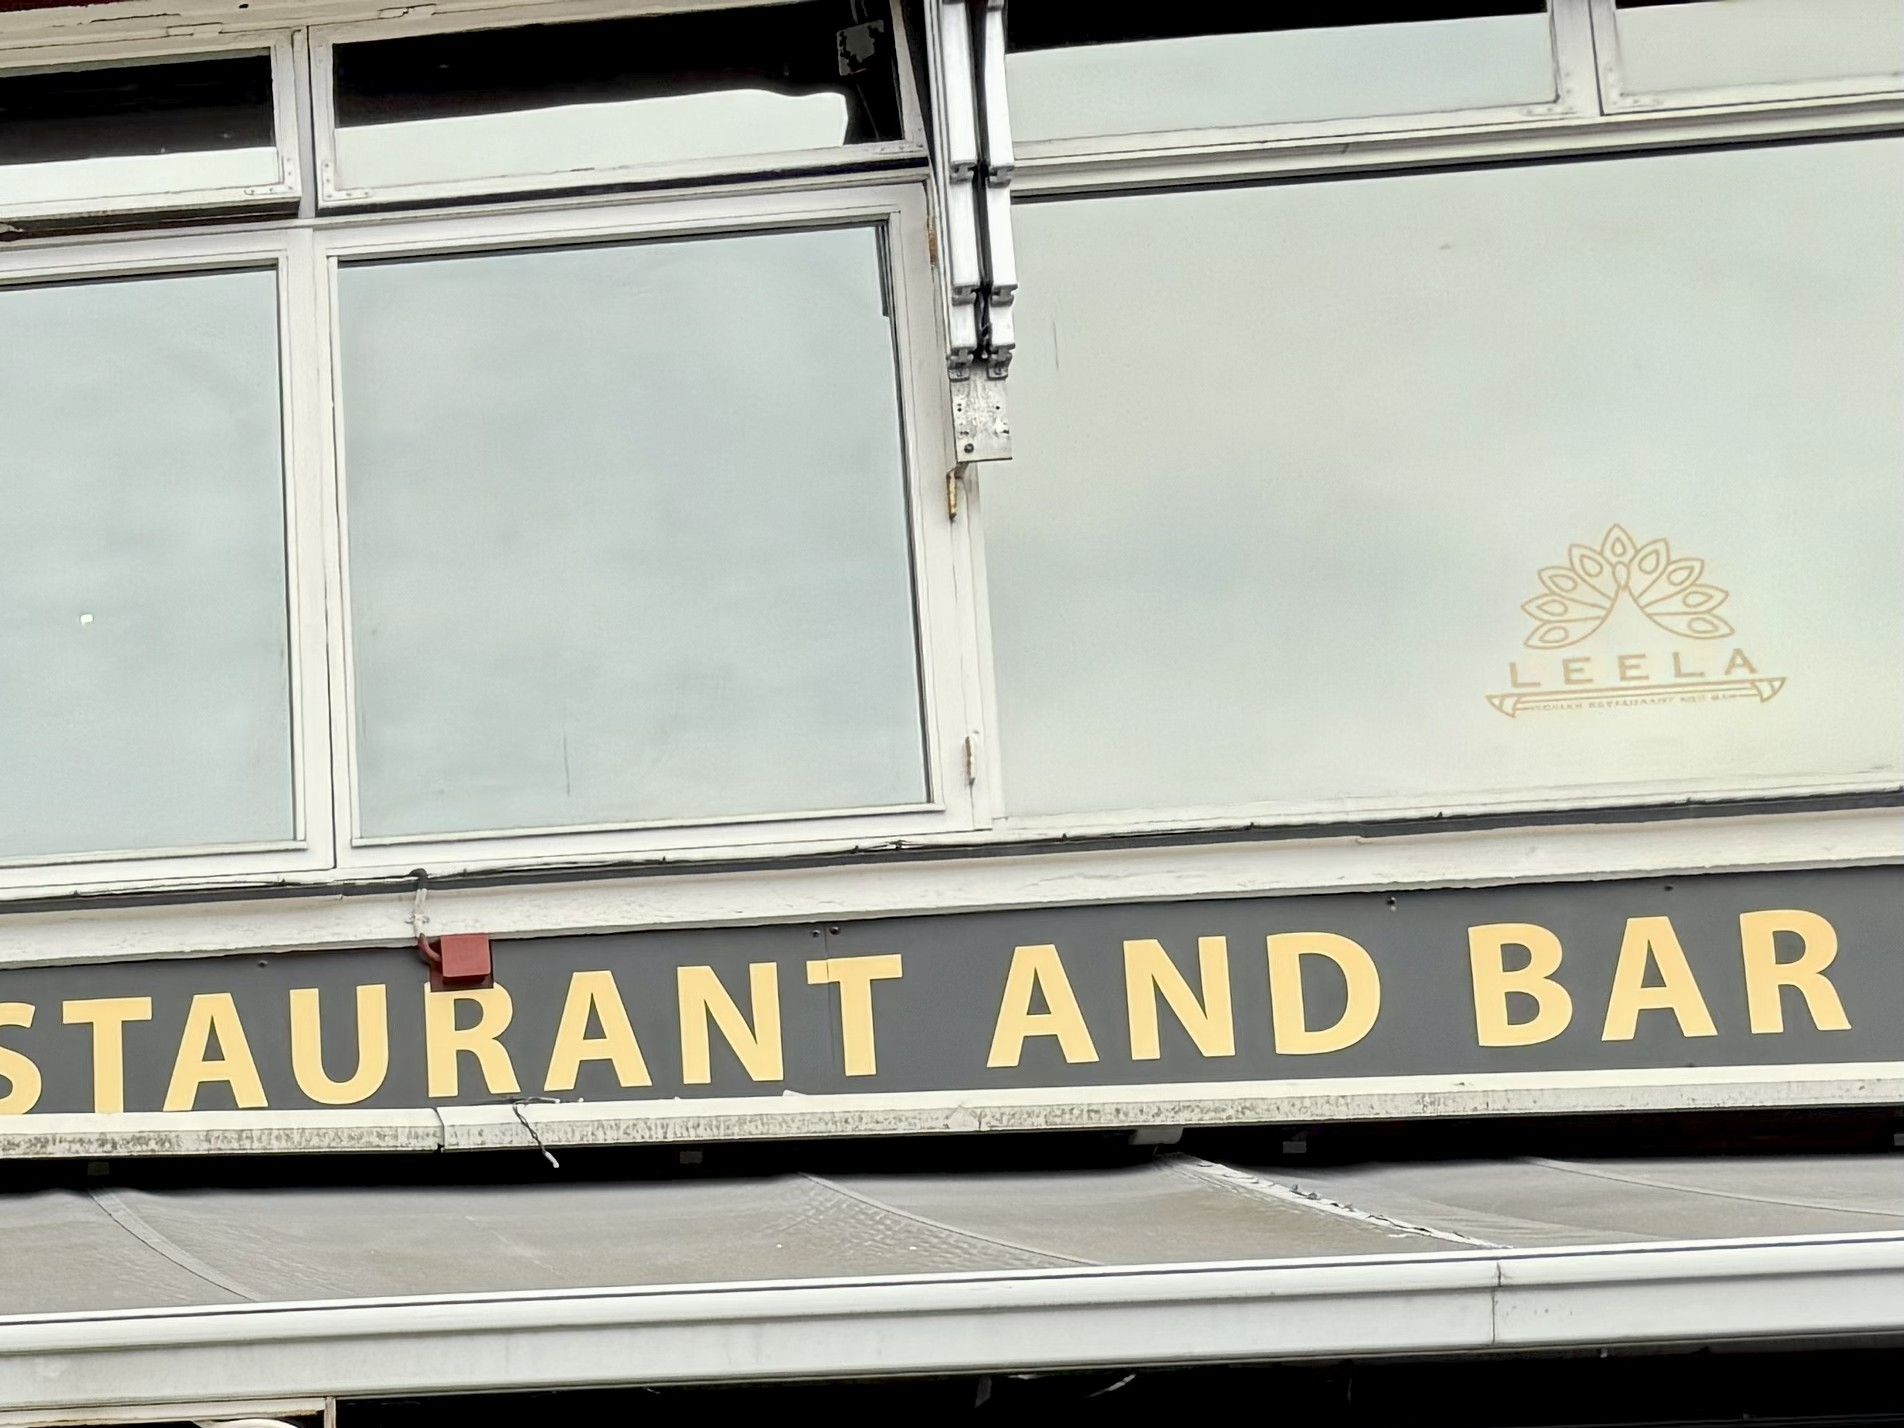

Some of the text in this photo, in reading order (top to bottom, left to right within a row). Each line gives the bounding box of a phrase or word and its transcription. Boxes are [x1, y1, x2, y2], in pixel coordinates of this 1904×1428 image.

[1508, 648, 1759, 688] LEELA
[988, 930, 1382, 1068] AND
[1467, 908, 1853, 1047] BAR
